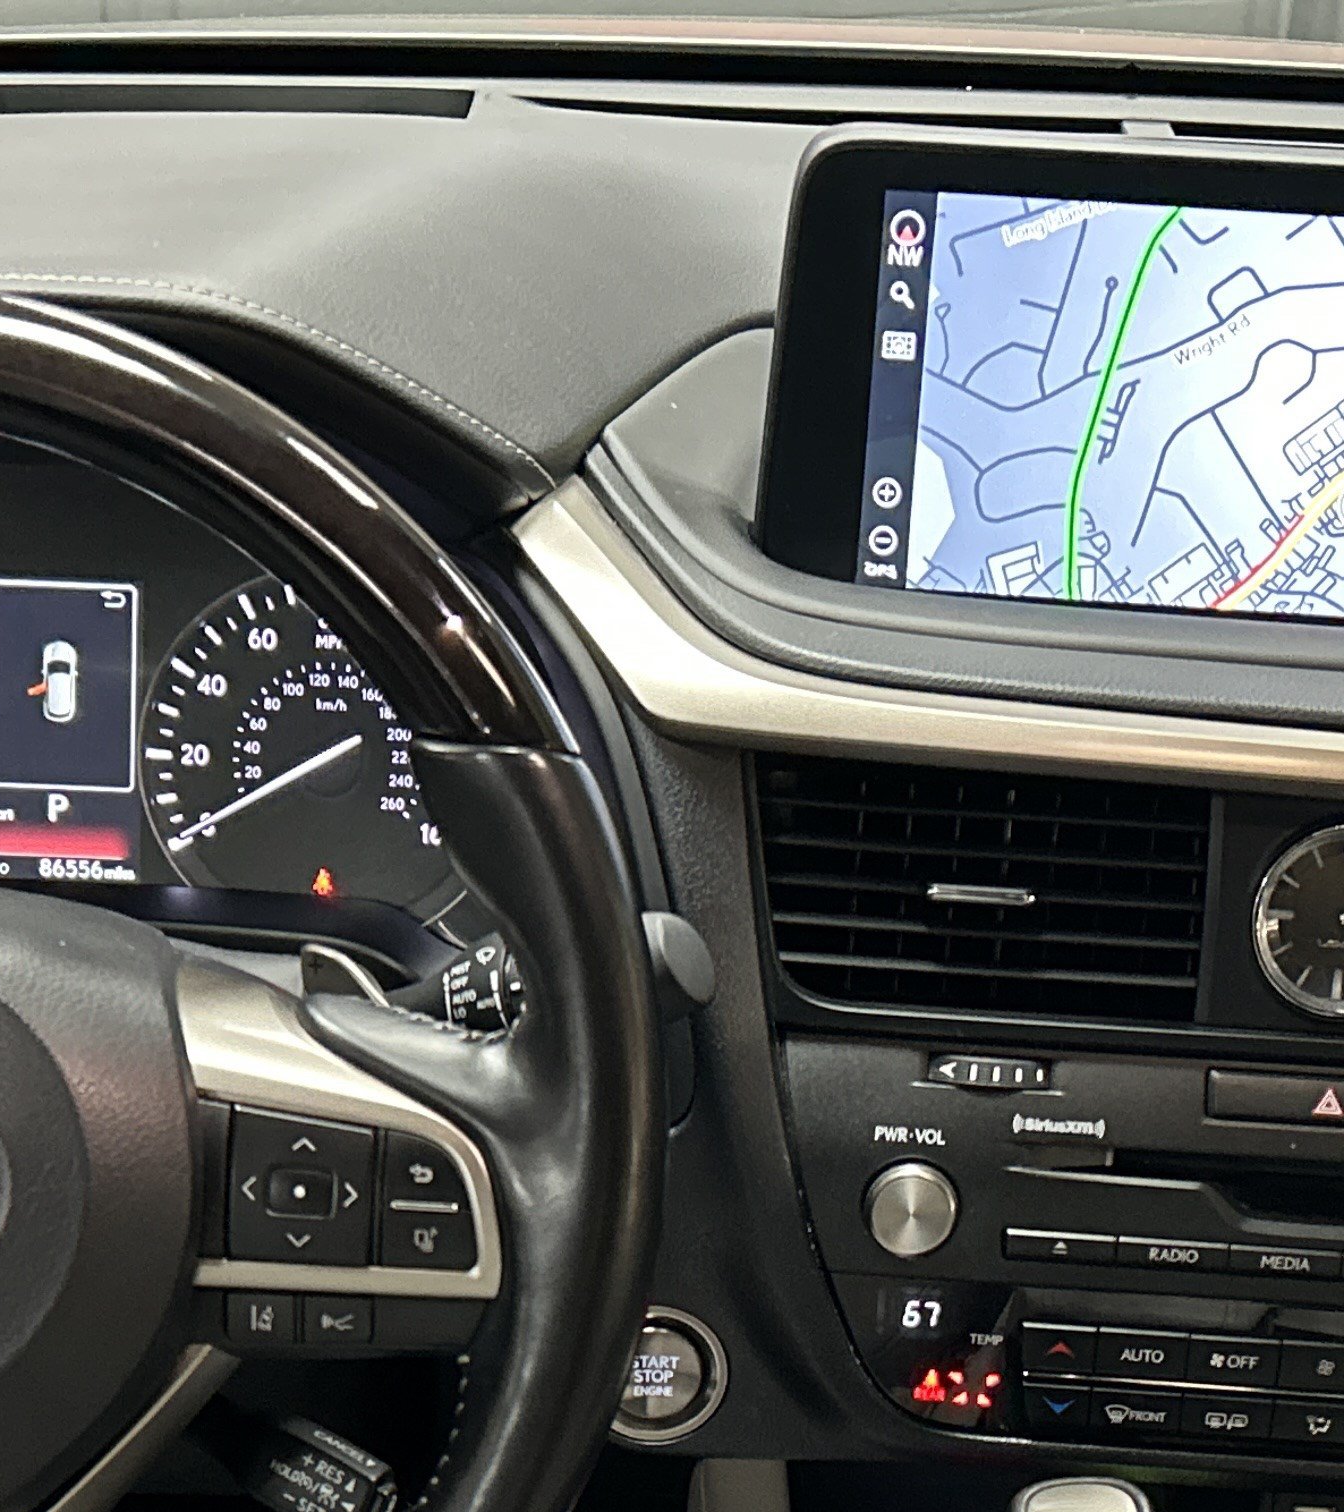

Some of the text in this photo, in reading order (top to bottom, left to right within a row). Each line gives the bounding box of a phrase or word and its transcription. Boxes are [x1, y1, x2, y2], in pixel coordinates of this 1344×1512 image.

[887, 244, 924, 267] NW
[1173, 314, 1252, 365] Wright Rd
[247, 627, 279, 651] 60
[196, 673, 228, 698] 40
[308, 672, 331, 688] 120
[337, 674, 359, 690] 140
[282, 682, 304, 697] 100
[263, 697, 281, 711] 80
[315, 697, 348, 713] km/h
[249, 716, 267, 732] 60
[386, 727, 413, 742] 200
[180, 742, 211, 768] 20
[243, 740, 261, 755] 40
[391, 750, 411, 764] 22
[244, 764, 262, 780] 20
[388, 773, 413, 789] 240
[47, 792, 71, 823] P
[380, 796, 405, 811] 260
[38, 857, 104, 881] 86556
[452, 987, 477, 1006] AUTO
[1148, 1245, 1200, 1265] RADIO
[1259, 1253, 1312, 1273] MEDIA
[901, 1299, 943, 1331] 67
[969, 1332, 1004, 1347] TEMP
[1120, 1348, 1165, 1364] AUTO
[1226, 1352, 1260, 1371] OFF
[634, 1369, 674, 1384] STOP
[632, 1384, 673, 1397] ENGINE
[1127, 1408, 1168, 1424] FRONT
[315, 1459, 346, 1485] RES
